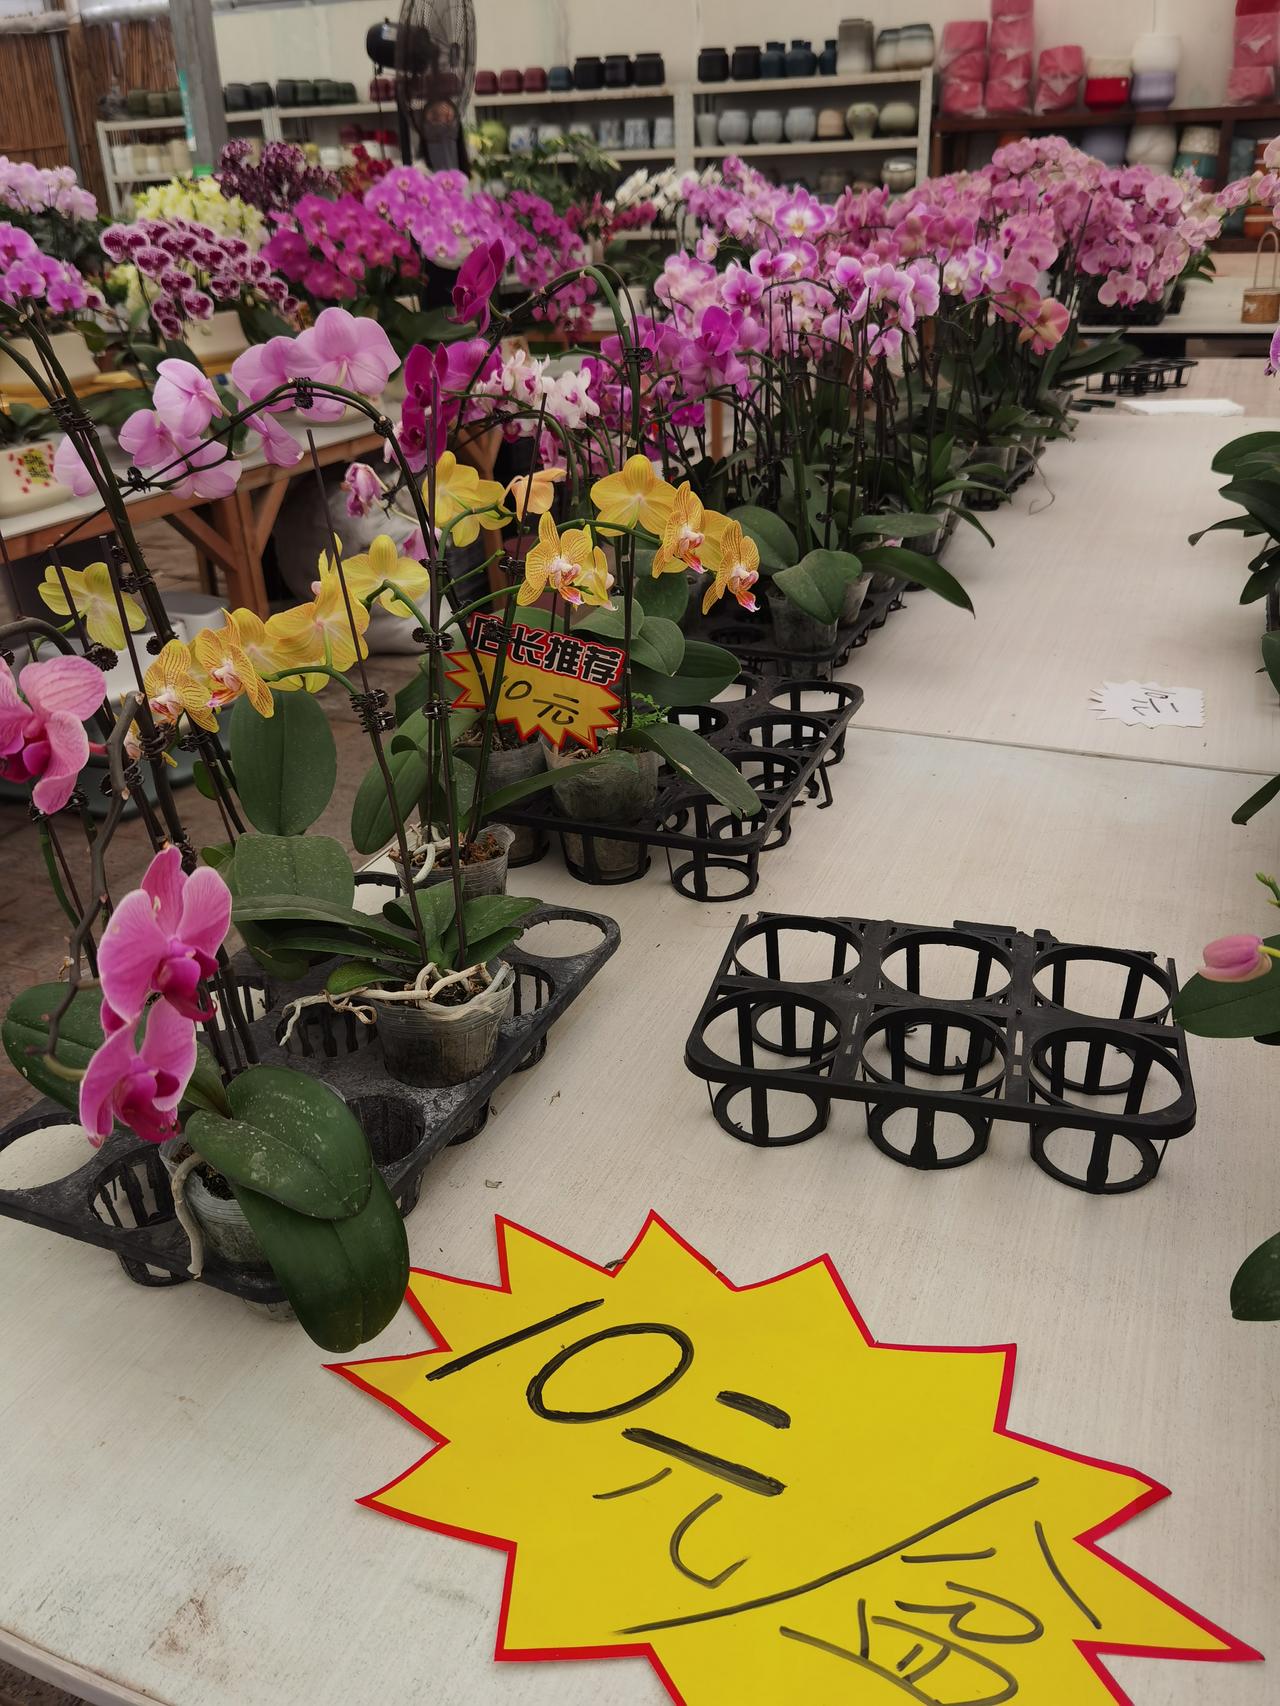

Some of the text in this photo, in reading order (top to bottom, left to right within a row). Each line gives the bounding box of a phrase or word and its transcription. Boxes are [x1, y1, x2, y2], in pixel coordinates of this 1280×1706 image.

[471, 616, 623, 685] 店长推荐
[499, 675, 579, 725] 0元
